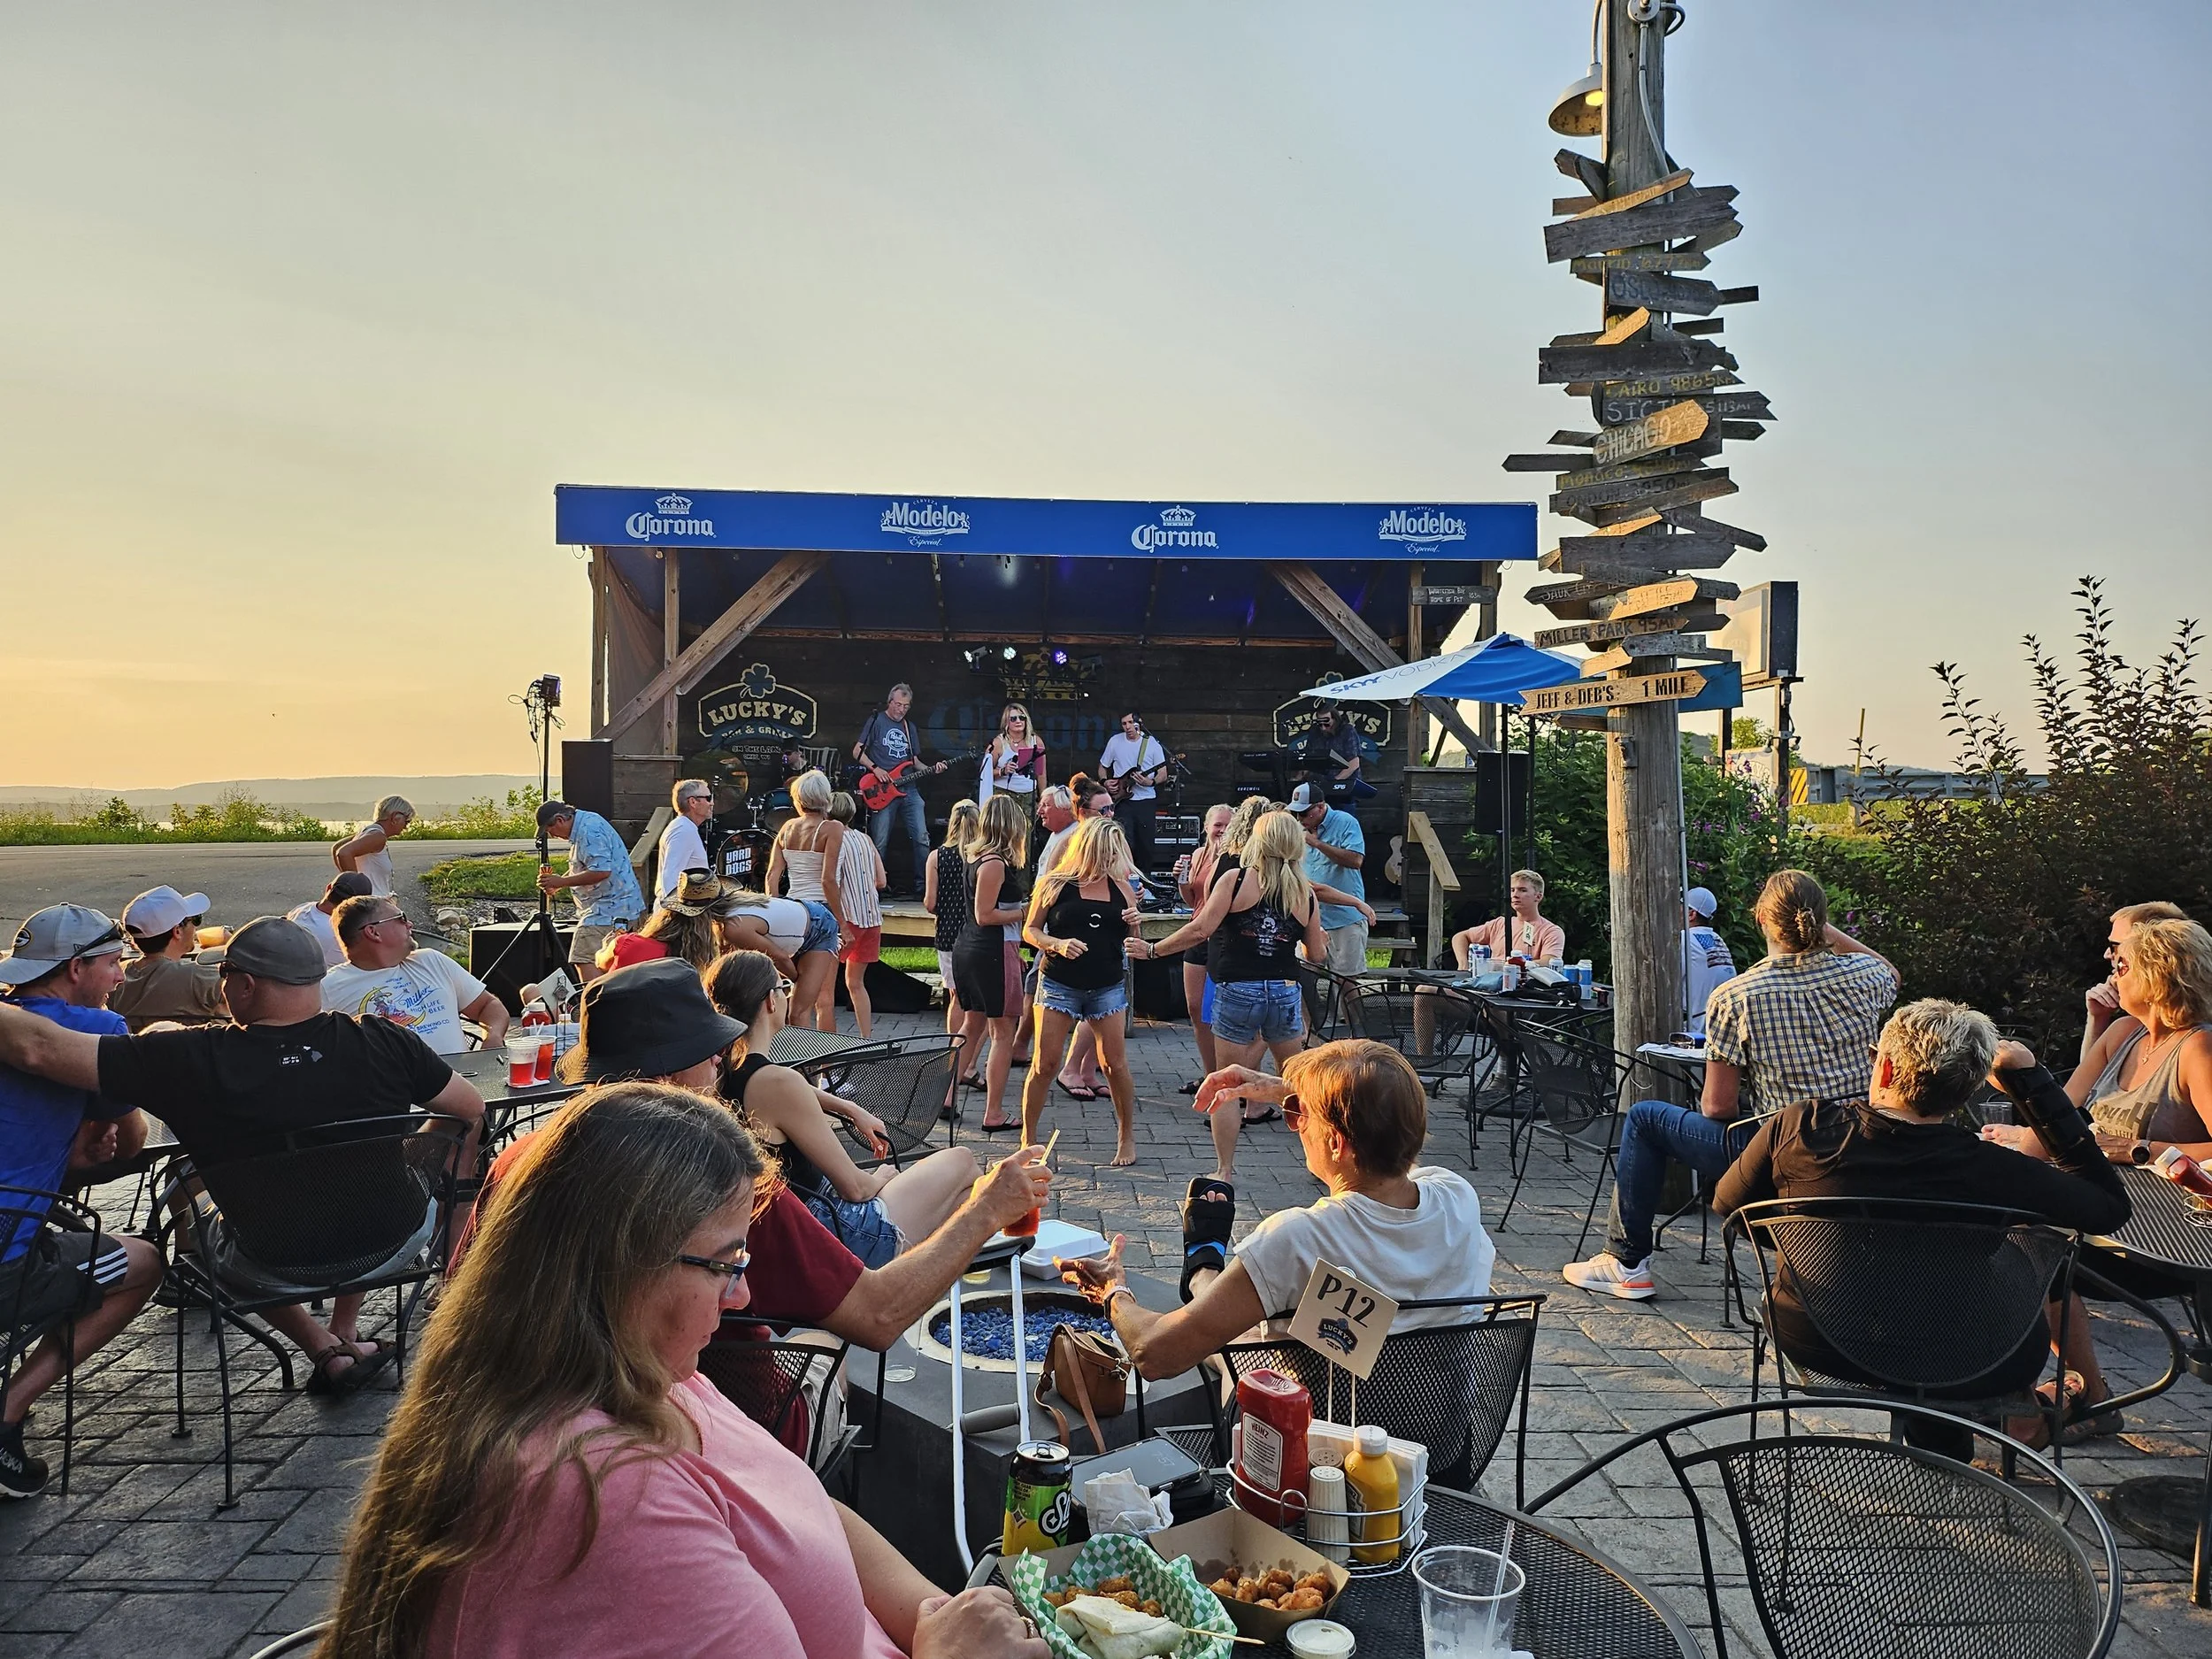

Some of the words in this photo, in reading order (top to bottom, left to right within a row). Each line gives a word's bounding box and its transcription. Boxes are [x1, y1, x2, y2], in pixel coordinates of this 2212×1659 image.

[1607, 397, 1676, 423] SICI
[626, 511, 715, 541] Corona
[892, 502, 959, 527] Modelo
[1389, 510, 1456, 534] Modelo
[1131, 524, 1217, 553] Corona
[1538, 626, 1591, 647] MILLER
[1595, 621, 1632, 639] PARK
[1330, 675, 1382, 695] SKYY
[1536, 692, 1561, 709] JEFF
[1564, 691, 1576, 705] &
[1642, 680, 1649, 697] 1
[708, 701, 807, 726] LUCKY'S
[745, 726, 755, 734] &
[726, 848, 751, 864] YARD
[726, 859, 752, 876] DOGS
[402, 985, 431, 1008] Miller
[411, 1003, 426, 1012] HIGH
[426, 999, 440, 1009] LIFE
[428, 1005, 445, 1014] BEER
[1317, 1272, 1376, 1328] P12
[1323, 1324, 1354, 1345] LUCKY'S
[1251, 1422, 1270, 1440] HEINZ
